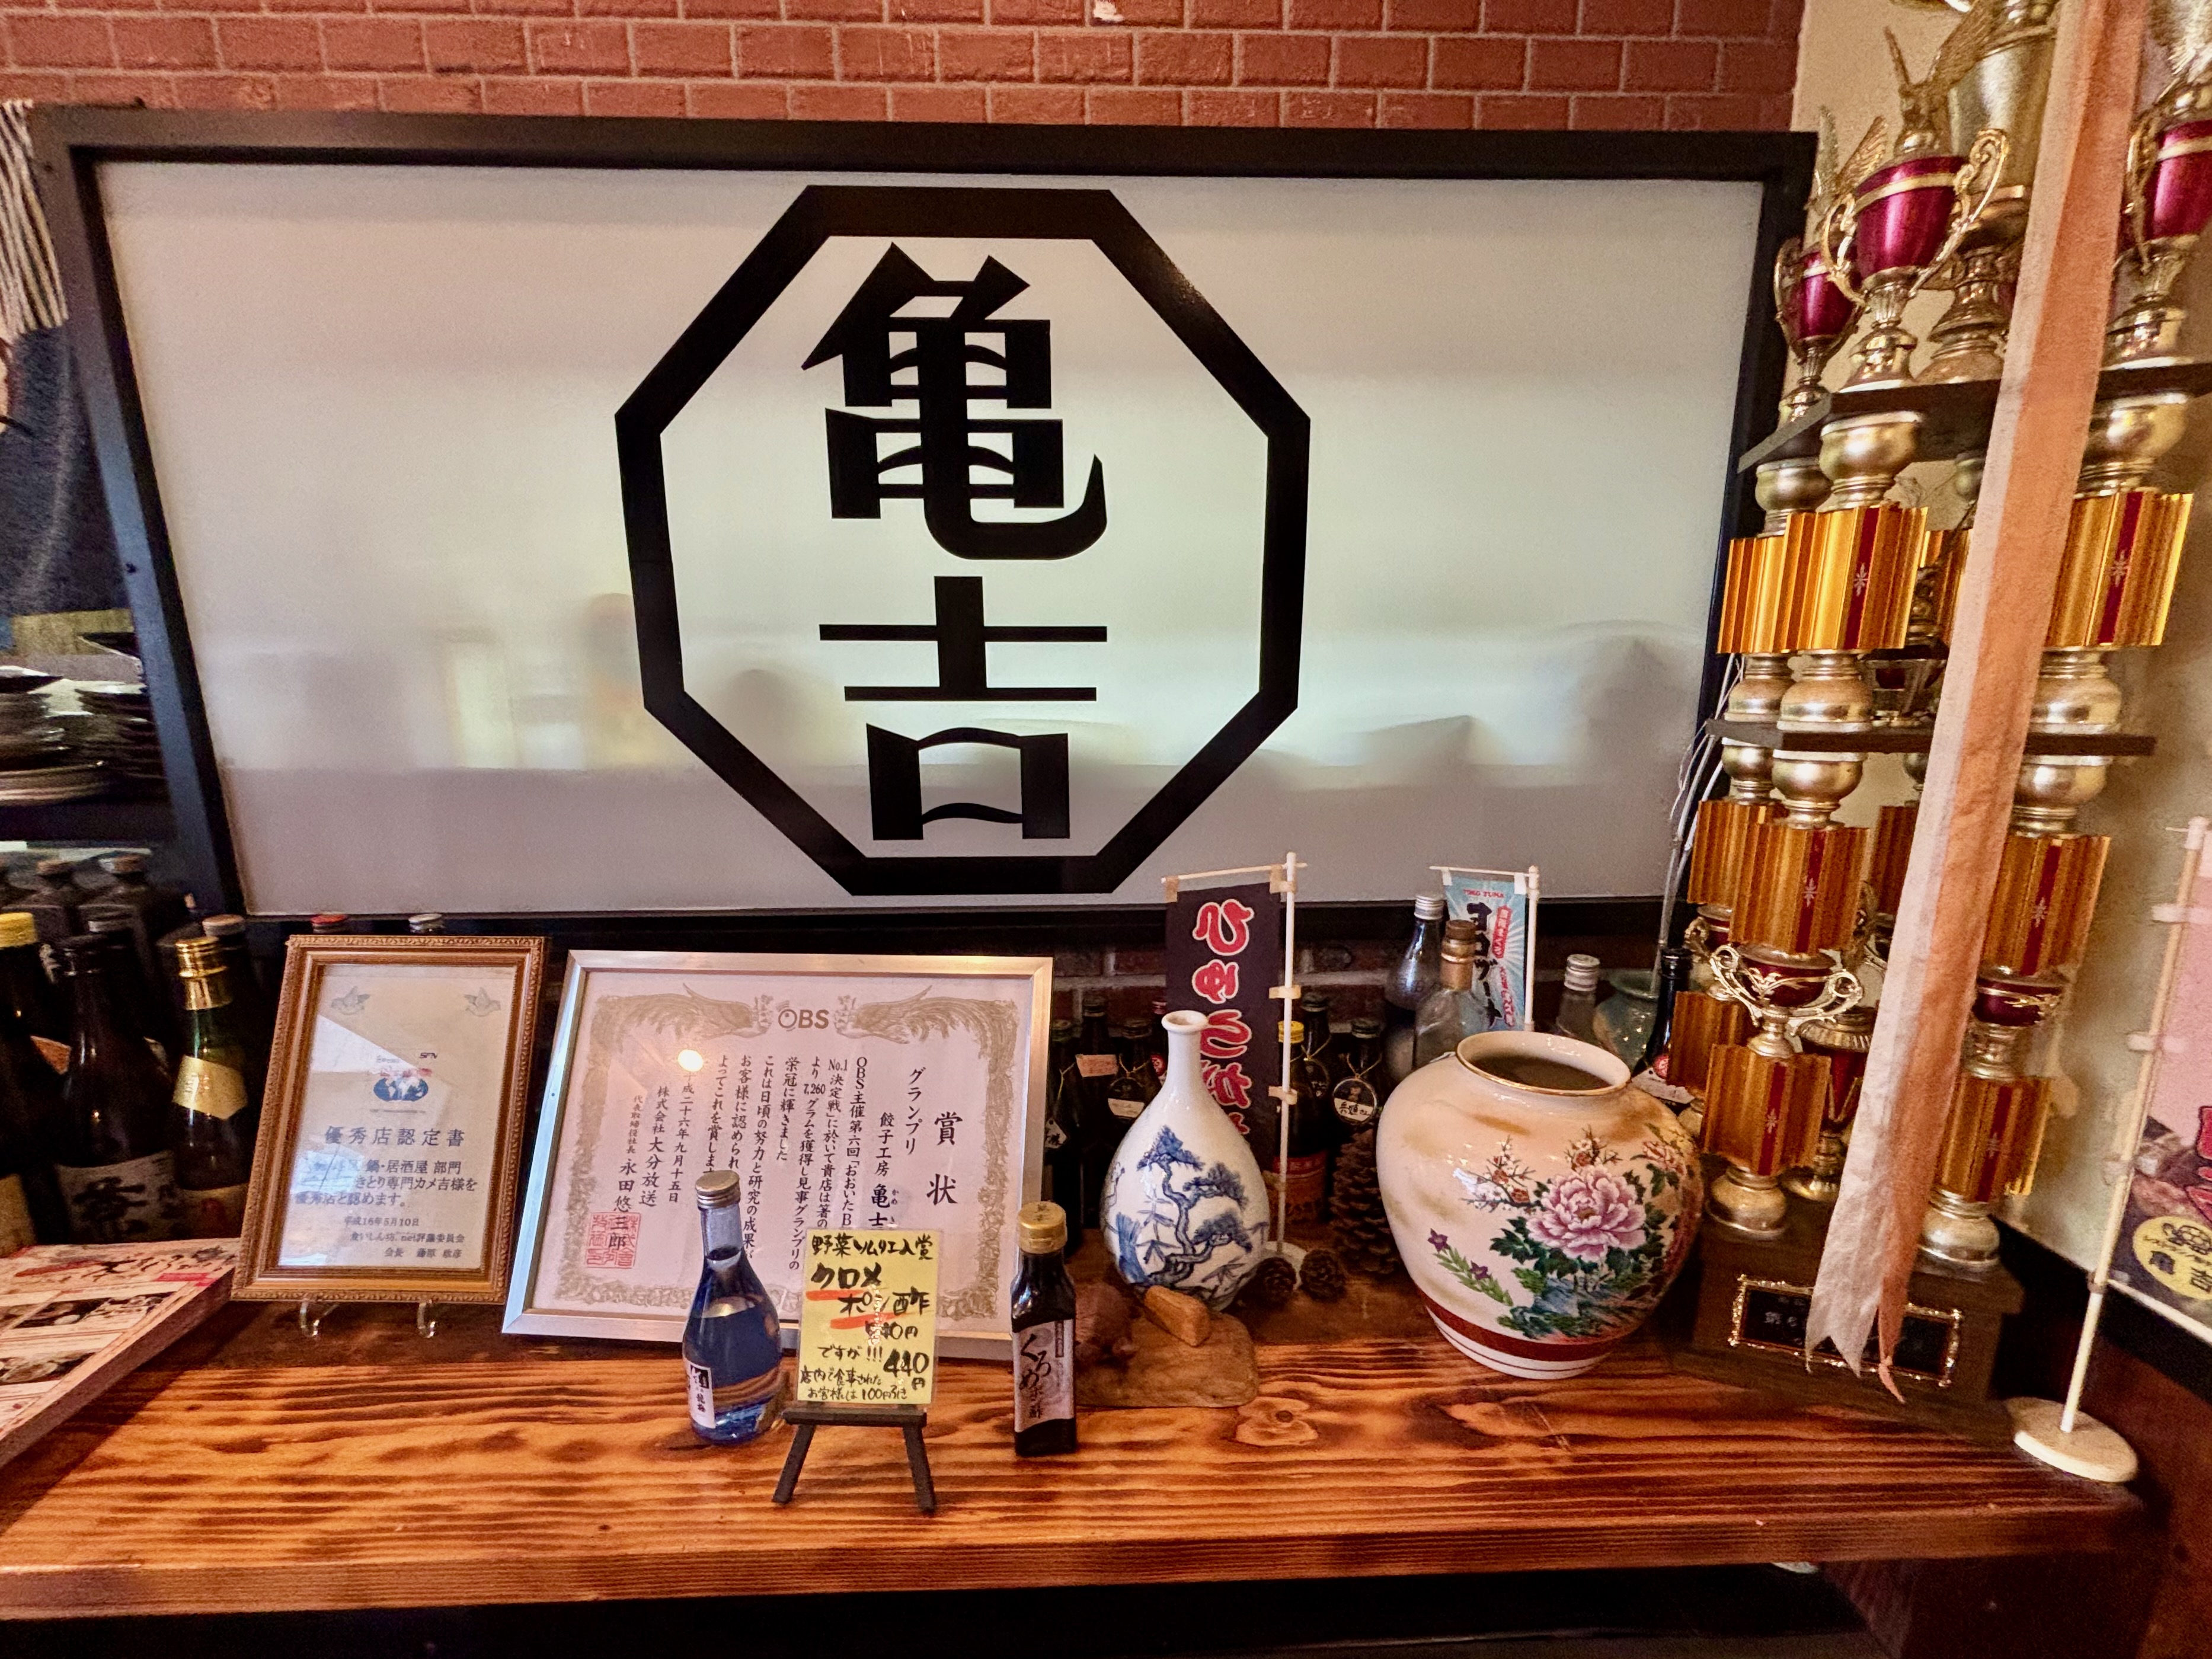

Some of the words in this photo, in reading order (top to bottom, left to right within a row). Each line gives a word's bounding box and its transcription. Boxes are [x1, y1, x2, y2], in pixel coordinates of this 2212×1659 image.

[801, 242, 1107, 841] 亀吉
[778, 1008, 829, 1030] OBS
[325, 1126, 465, 1147] 優秀店認定書
[703, 1054, 728, 1174] よってこれを賞しま
[728, 1055, 752, 1169] お客様に認められ
[776, 1056, 800, 1161] 栄冠に輝きました
[874, 1111, 895, 1177] 餃子工房
[905, 1066, 926, 1155] グランプリ
[926, 1111, 963, 1206] 賞状
[810, 1262, 883, 1290] クロメ
